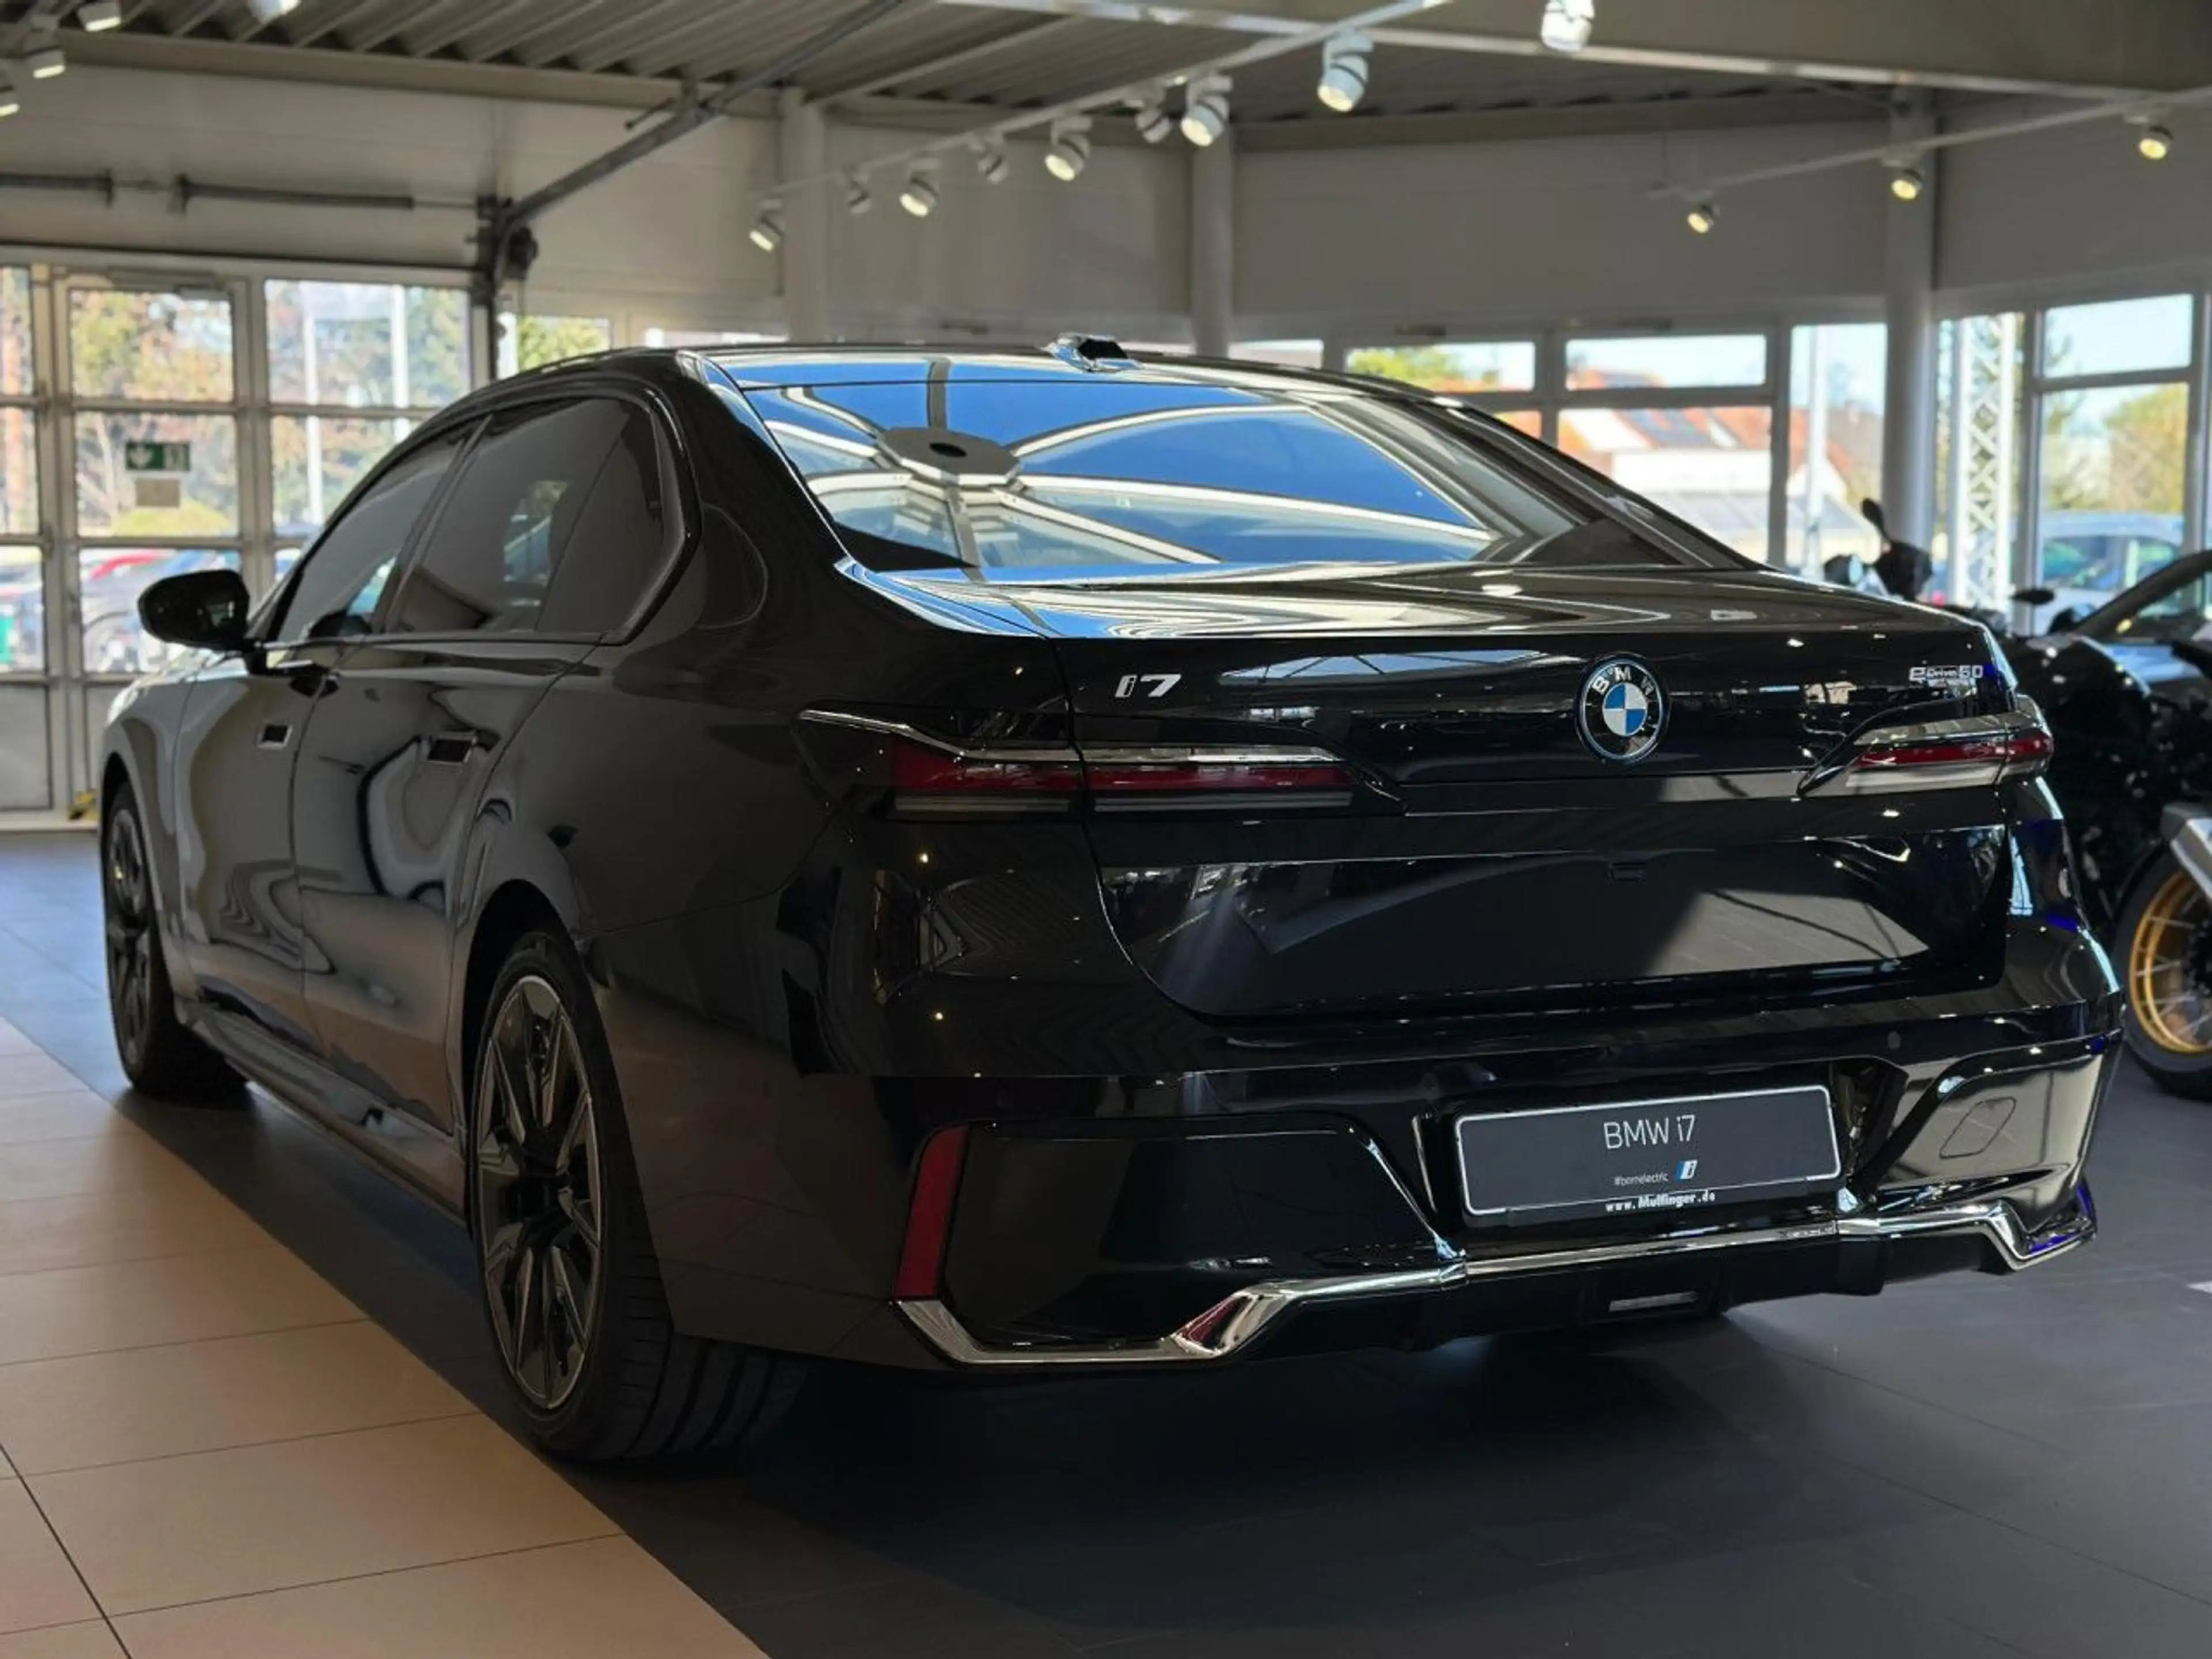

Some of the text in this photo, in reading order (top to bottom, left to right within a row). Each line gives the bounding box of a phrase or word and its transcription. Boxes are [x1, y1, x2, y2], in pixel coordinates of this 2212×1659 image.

[1604, 1114, 1696, 1149] BMW i7
[1615, 1173, 1668, 1185] #bornelectric
